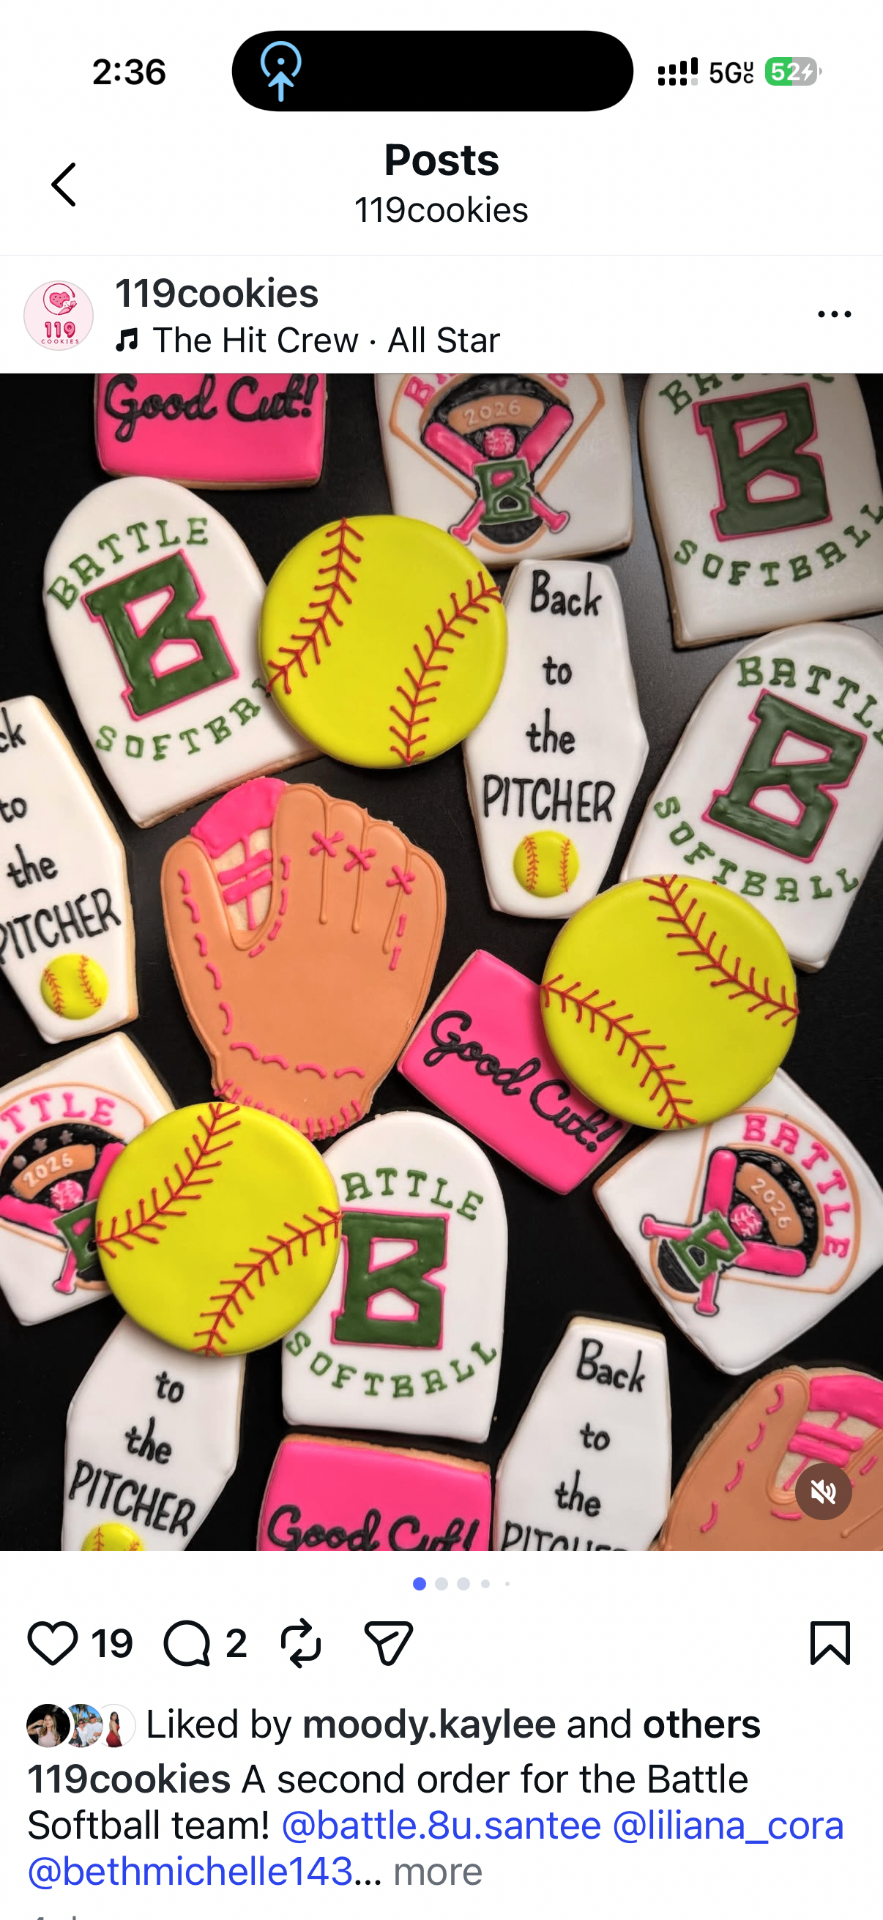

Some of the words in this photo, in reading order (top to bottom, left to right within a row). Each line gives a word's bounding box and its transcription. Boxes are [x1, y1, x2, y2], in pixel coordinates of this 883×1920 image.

[93, 58, 166, 85] 2:36
[771, 63, 800, 81] 52
[386, 143, 499, 176] Posts
[356, 195, 528, 223] 119cookies
[116, 277, 318, 308] 119cookies
[45, 321, 76, 338] 119
[153, 326, 211, 353] The
[224, 326, 266, 352] Hit
[278, 327, 358, 353] Crew
[388, 326, 424, 352] All
[438, 327, 500, 353] Star
[104, 374, 217, 442] Good
[227, 374, 318, 422] Cut!
[463, 401, 522, 427] 2026
[692, 382, 833, 542] B
[474, 458, 534, 525] B
[47, 517, 209, 610] BATTLE
[674, 504, 883, 586] SOFTBALL
[530, 569, 602, 617] Back
[80, 549, 240, 722] B
[542, 656, 573, 685] to
[526, 708, 576, 755] the
[482, 774, 616, 823] PITCHER
[701, 688, 868, 864] B
[7, 843, 58, 888] the
[653, 796, 859, 902] SOFTBALL
[424, 1010, 541, 1096] Good
[530, 1079, 624, 1153] Cut!
[0, 1092, 116, 1150] TTLE
[23, 1153, 74, 1189] 2026
[341, 1167, 484, 1221] ATTLE
[742, 1114, 851, 1258] BATTLE
[750, 1178, 793, 1229] 2026
[330, 1206, 450, 1350] B
[155, 1371, 185, 1403] to
[285, 1331, 497, 1398] SOFTBALL
[576, 1338, 646, 1393] Back
[125, 1416, 172, 1464] the
[580, 1421, 610, 1451] to
[68, 1459, 196, 1537] PITCHER
[554, 1469, 602, 1517] the
[267, 1504, 380, 1551] Good
[92, 1628, 133, 1658] 19
[227, 1628, 247, 1657] 2
[148, 1708, 237, 1738] Liked
[252, 1708, 292, 1746] by
[304, 1708, 555, 1746] moody.kaylee
[568, 1708, 630, 1738] and
[644, 1708, 760, 1738] others
[28, 1763, 230, 1793] 119cookies
[242, 1765, 265, 1793] A
[278, 1763, 403, 1793] second
[418, 1763, 510, 1793] order
[521, 1763, 568, 1793] for
[579, 1763, 635, 1793] the
[649, 1763, 748, 1793] Battle
[28, 1809, 158, 1840] Softball
[171, 1811, 268, 1840] team!
[283, 1809, 601, 1844] @battle.8u.santee
[614, 1809, 843, 1845] @liliana_cora
[395, 1864, 482, 1886] more
